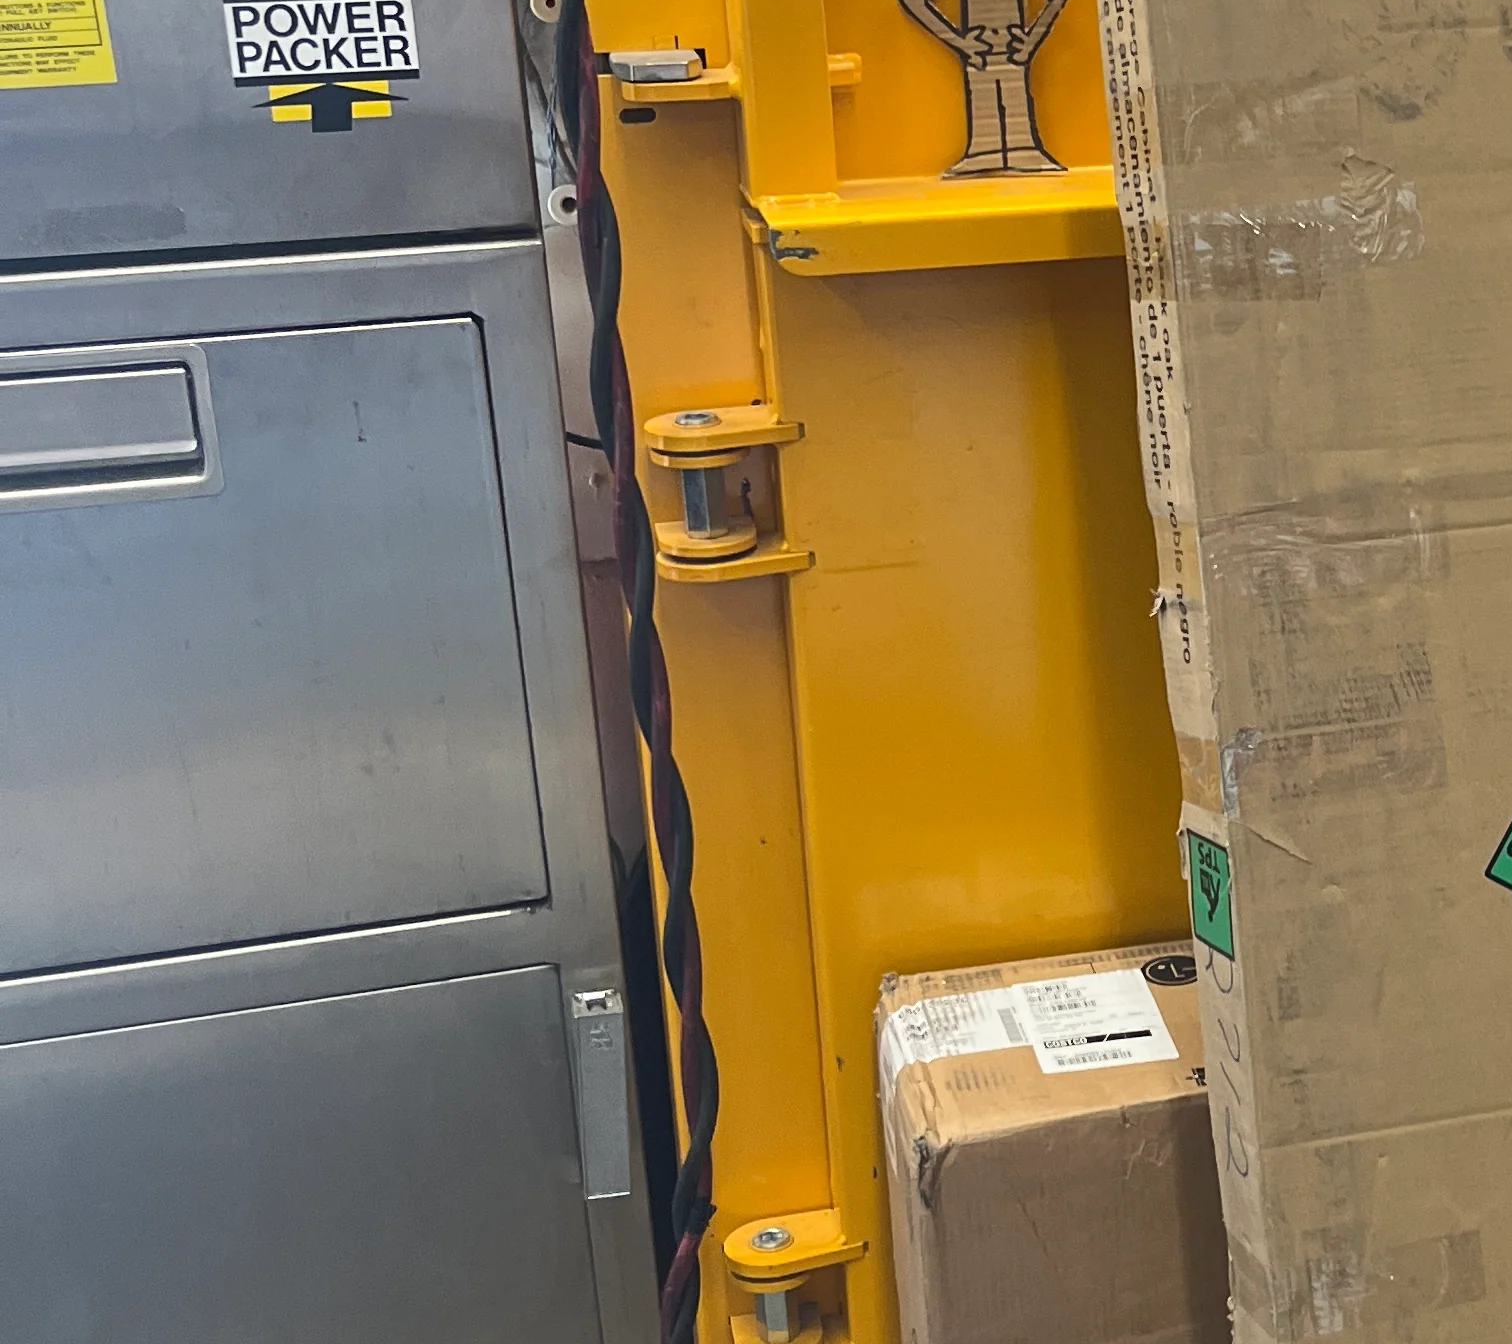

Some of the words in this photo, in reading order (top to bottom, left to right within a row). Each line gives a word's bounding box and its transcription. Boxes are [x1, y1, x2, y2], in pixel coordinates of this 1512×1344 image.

[232, 0, 407, 38] POWER
[236, 35, 411, 73] PACKER
[1118, 43, 1154, 293] almacenamiento
[1106, 28, 1130, 190] rangement
[1127, 226, 1143, 304] porte
[1139, 335, 1155, 423] chêne
[1150, 433, 1163, 490] noir
[1137, 87, 1157, 203] Cabinet
[1162, 328, 1174, 382] oak
[1148, 303, 1159, 339] de
[1153, 376, 1171, 469] puerta
[1167, 501, 1183, 573] roble
[1175, 583, 1192, 664] negro
[1197, 842, 1220, 874] TPS
